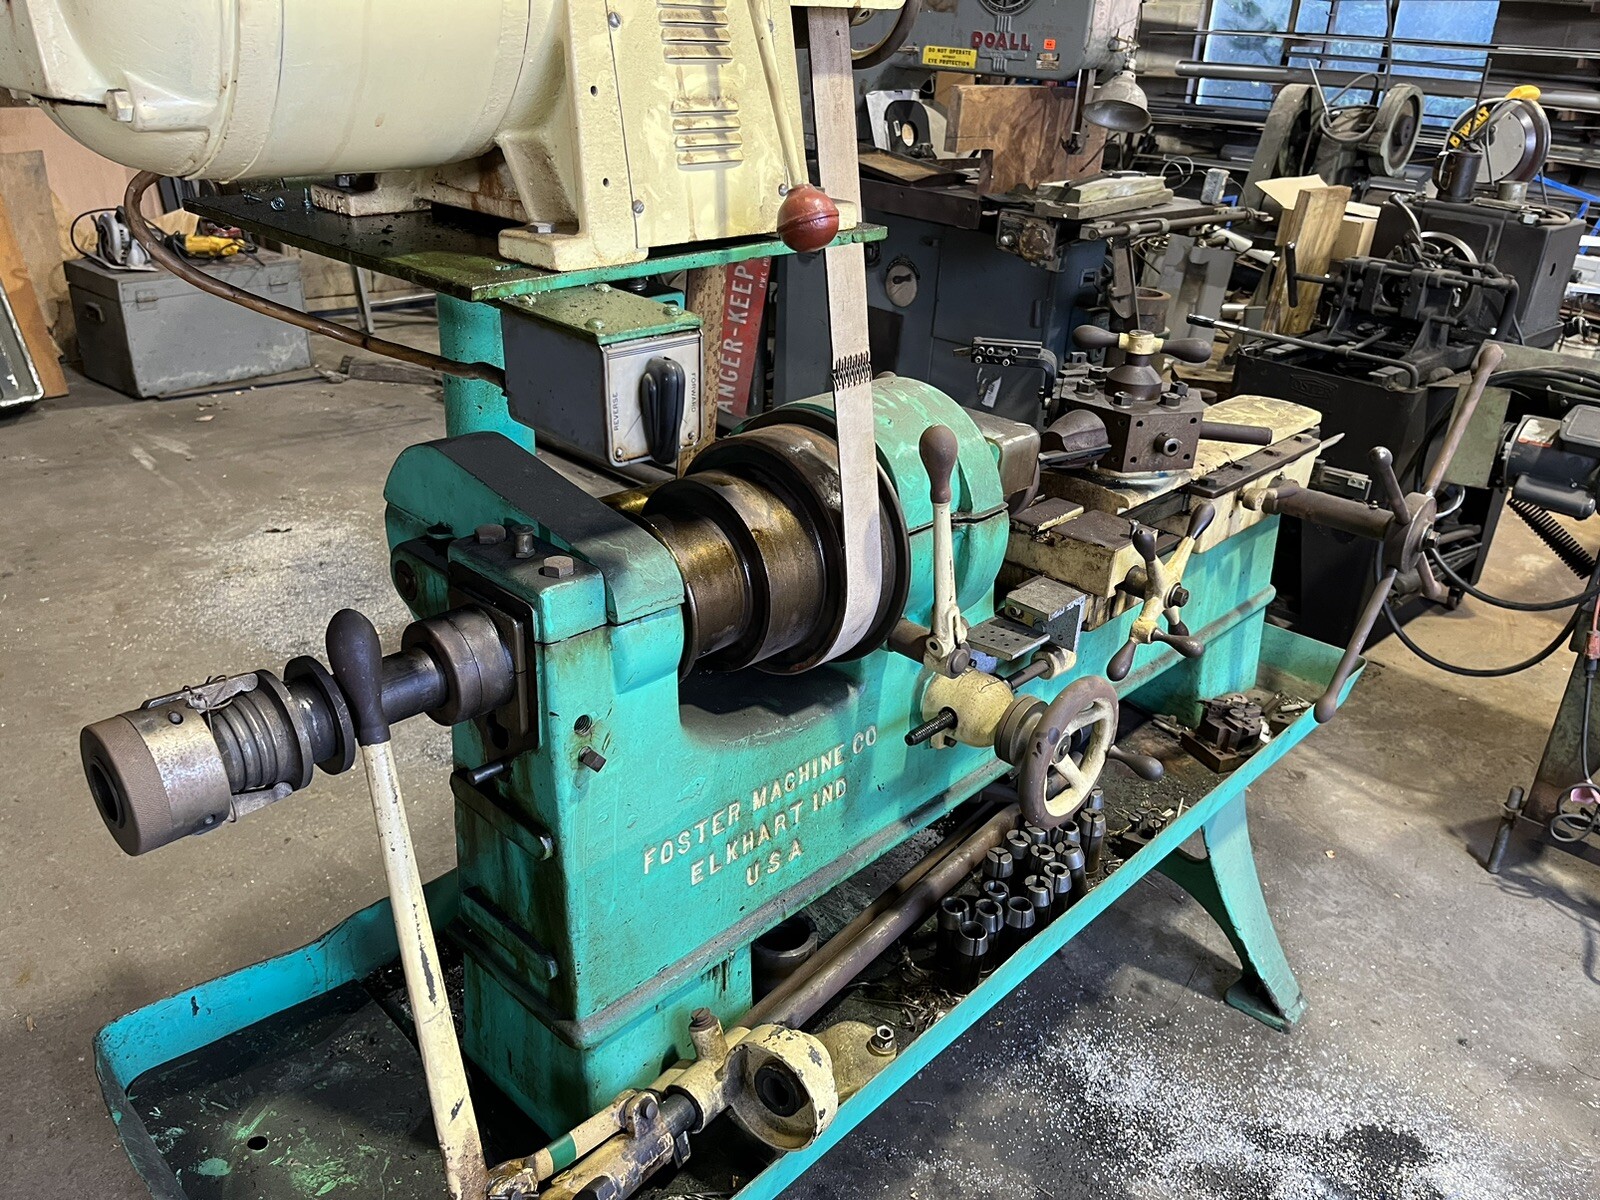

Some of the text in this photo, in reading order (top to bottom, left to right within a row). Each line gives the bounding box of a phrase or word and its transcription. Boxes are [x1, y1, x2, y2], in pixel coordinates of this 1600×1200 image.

[971, 31, 1031, 51] DOALL
[1450, 106, 1490, 149] DWALT
[643, 725, 877, 875] FOSTER MACHINE CO
[691, 777, 848, 886] ELKHART IND
